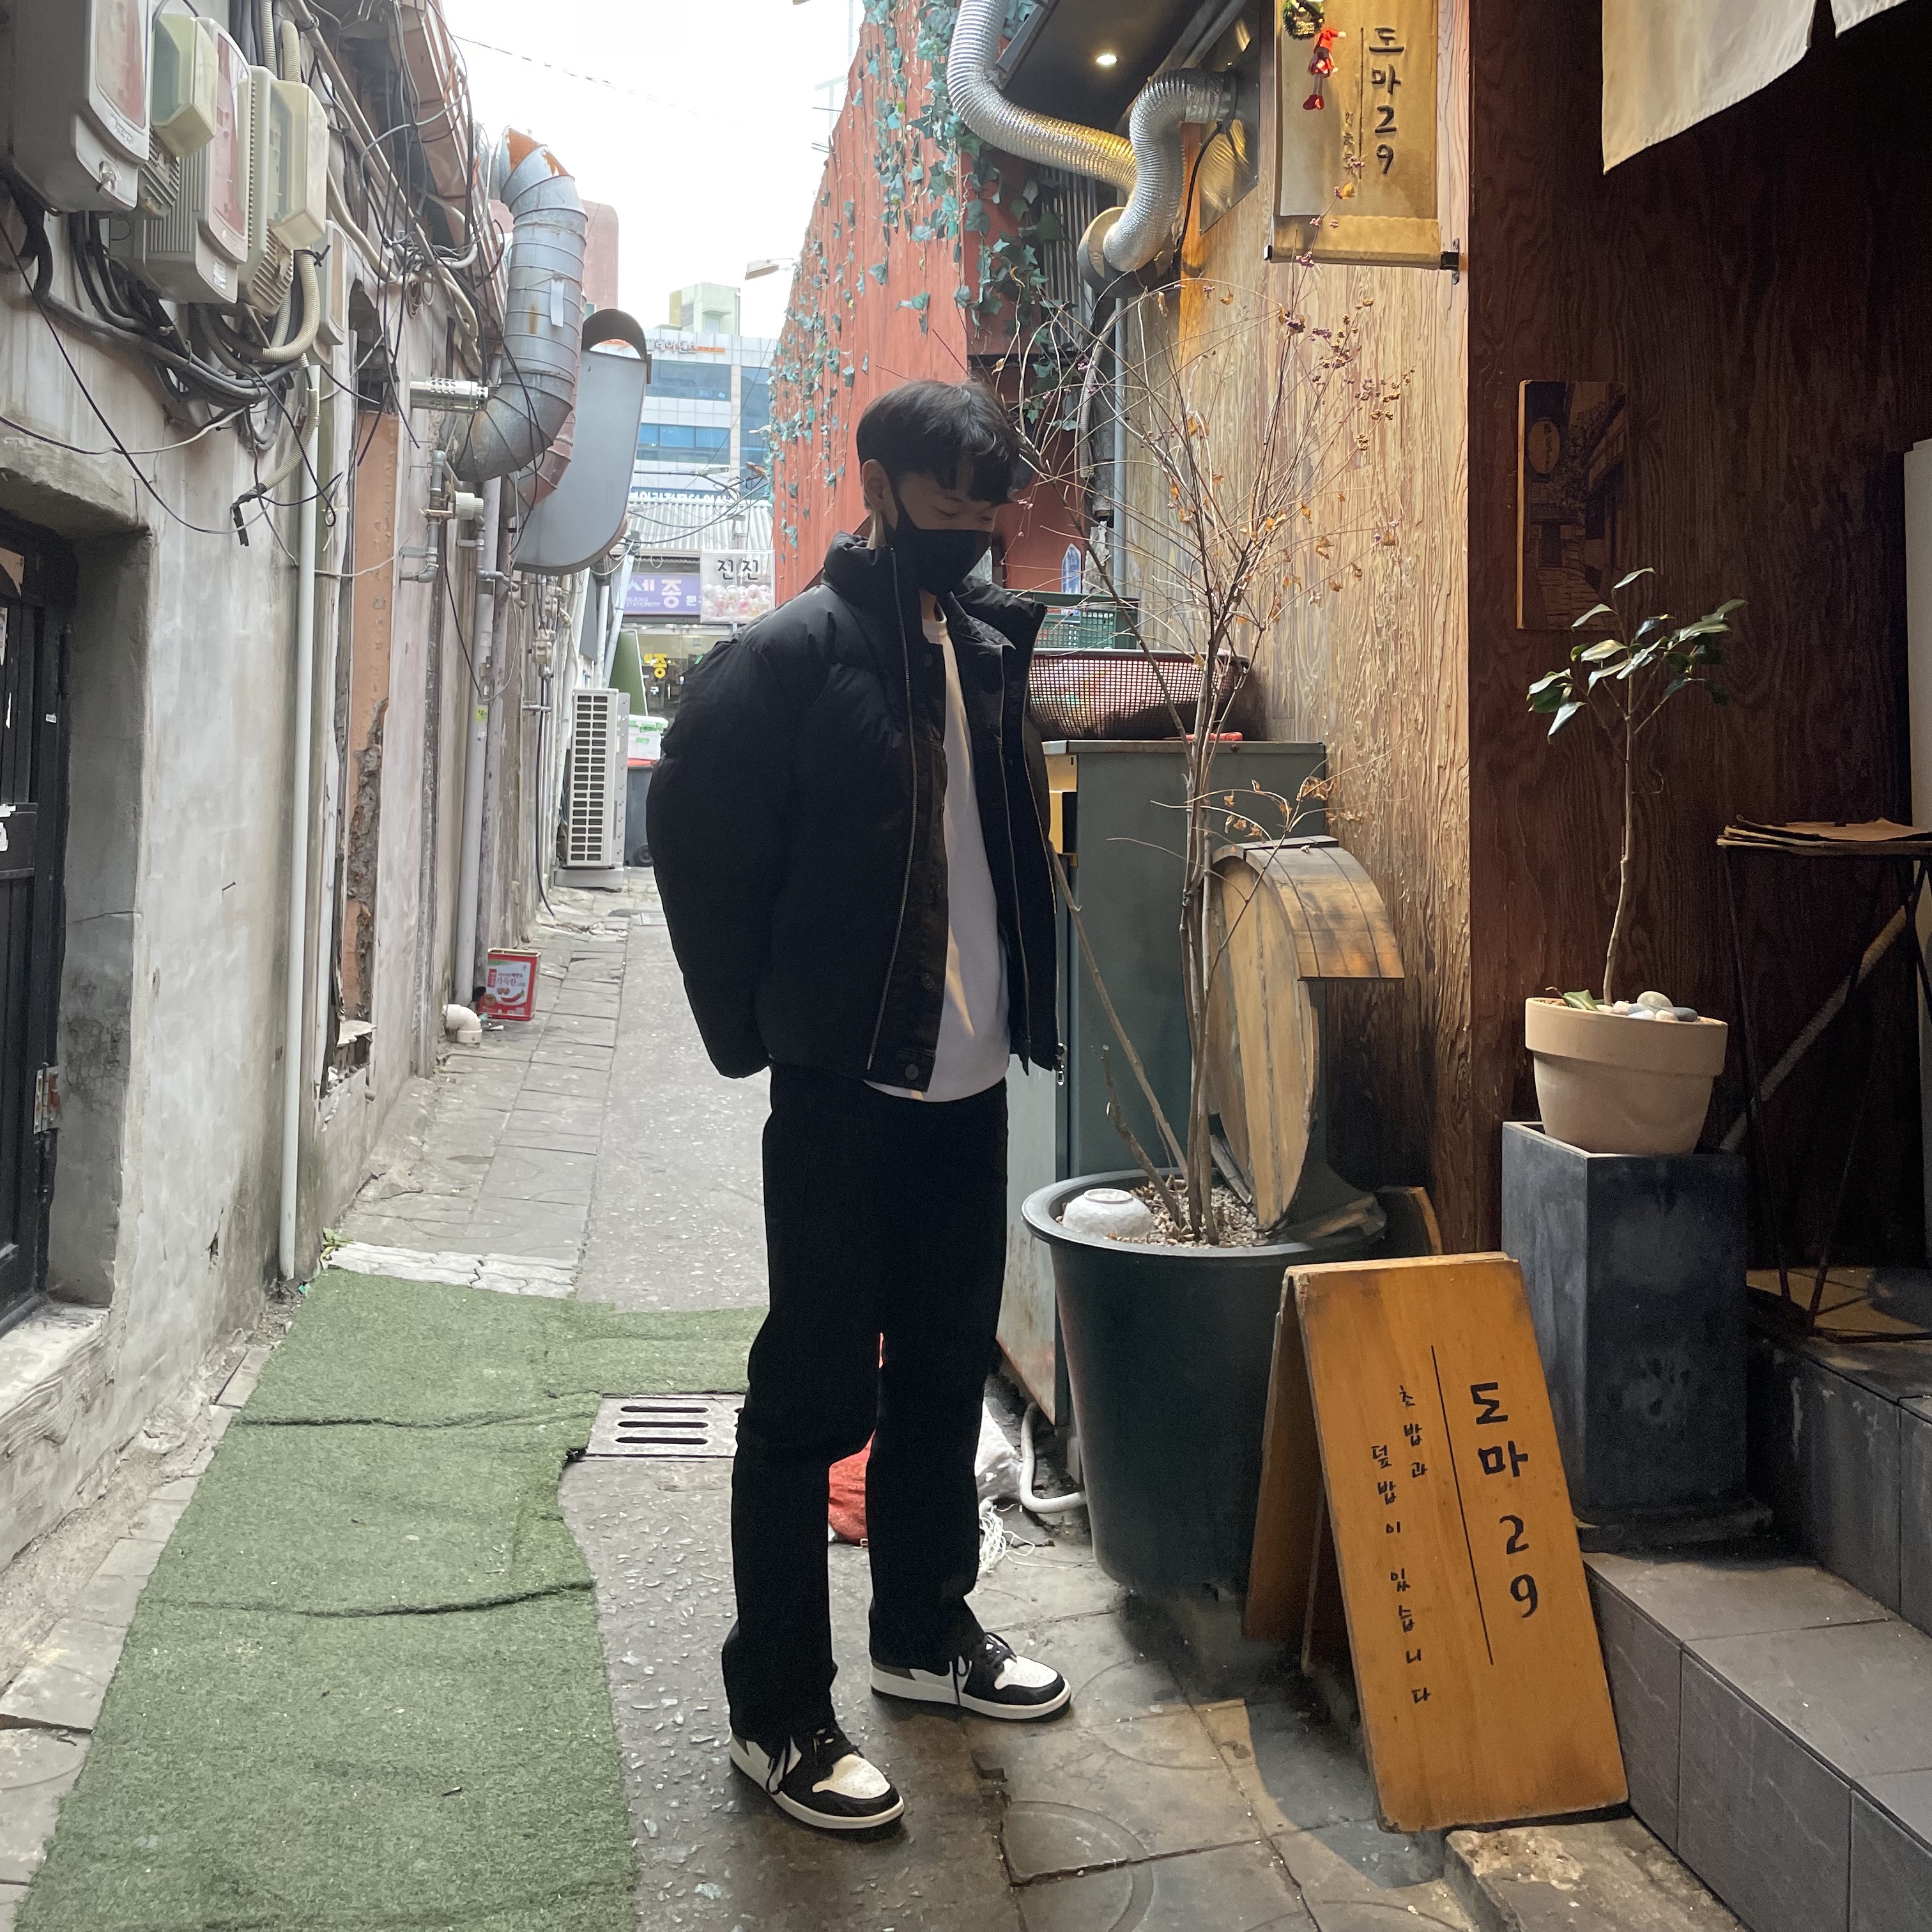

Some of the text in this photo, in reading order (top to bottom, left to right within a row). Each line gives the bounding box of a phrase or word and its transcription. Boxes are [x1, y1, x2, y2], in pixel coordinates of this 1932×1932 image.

[1369, 27, 1404, 174] 도마29
[1399, 1384, 1428, 1478] 초밥과
[1499, 1514, 1538, 1618] 29
[1390, 1567, 1431, 1705] 있습니다
